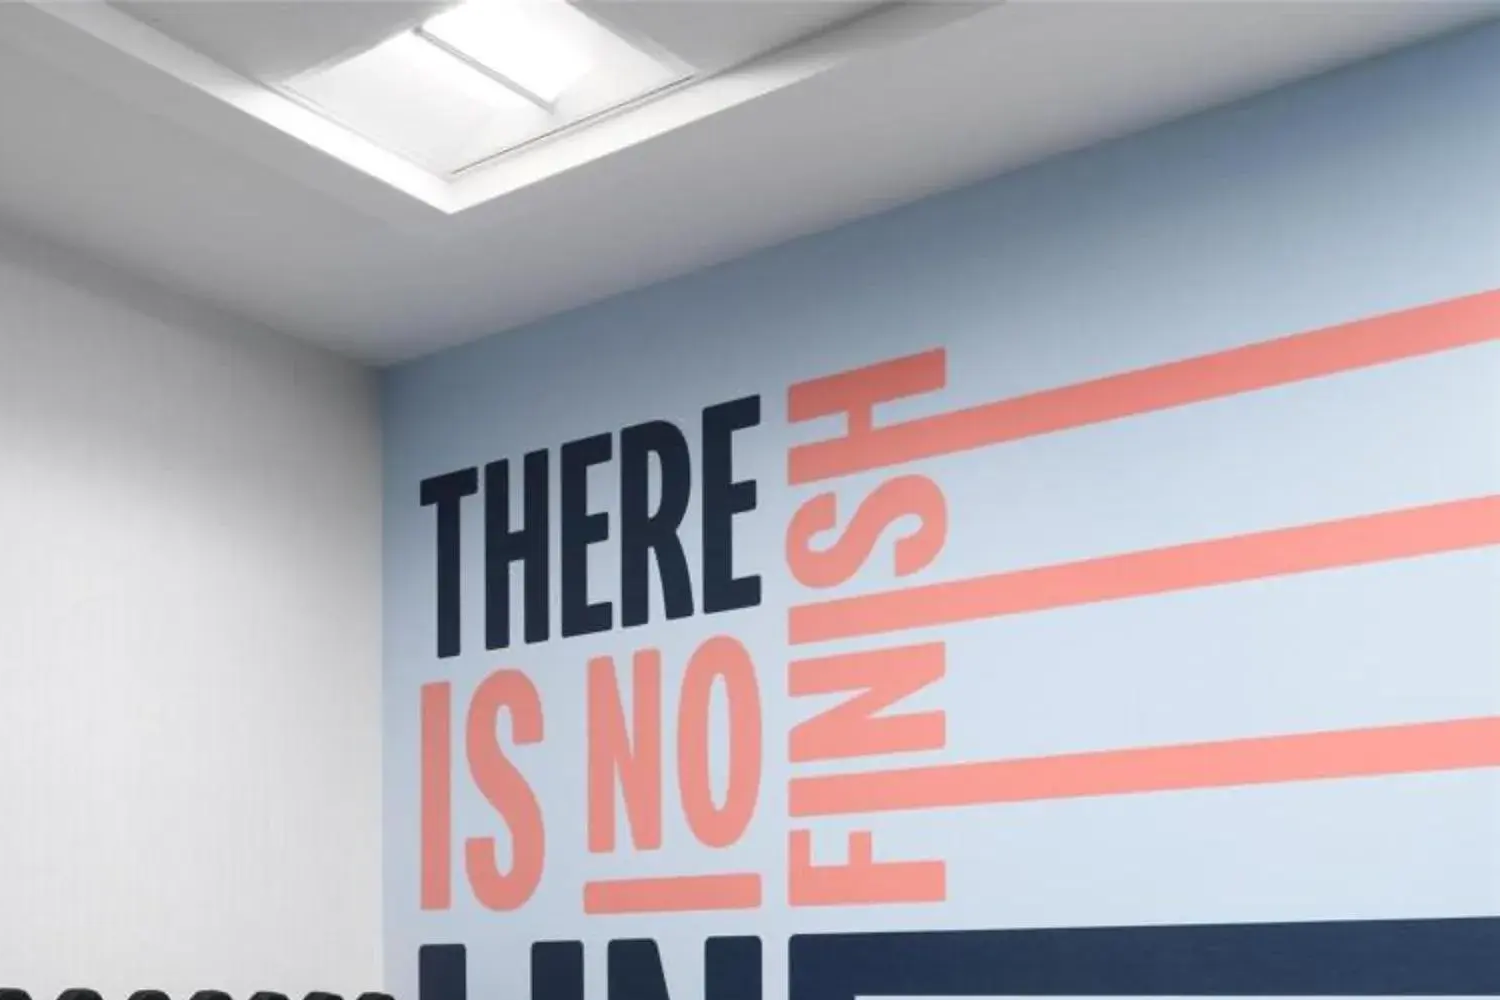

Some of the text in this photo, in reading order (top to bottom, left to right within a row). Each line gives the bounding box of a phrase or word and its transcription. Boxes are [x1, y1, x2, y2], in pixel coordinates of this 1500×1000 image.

[420, 394, 761, 659] THERE
[786, 347, 948, 907] FINISH
[420, 635, 762, 912] IS NO
